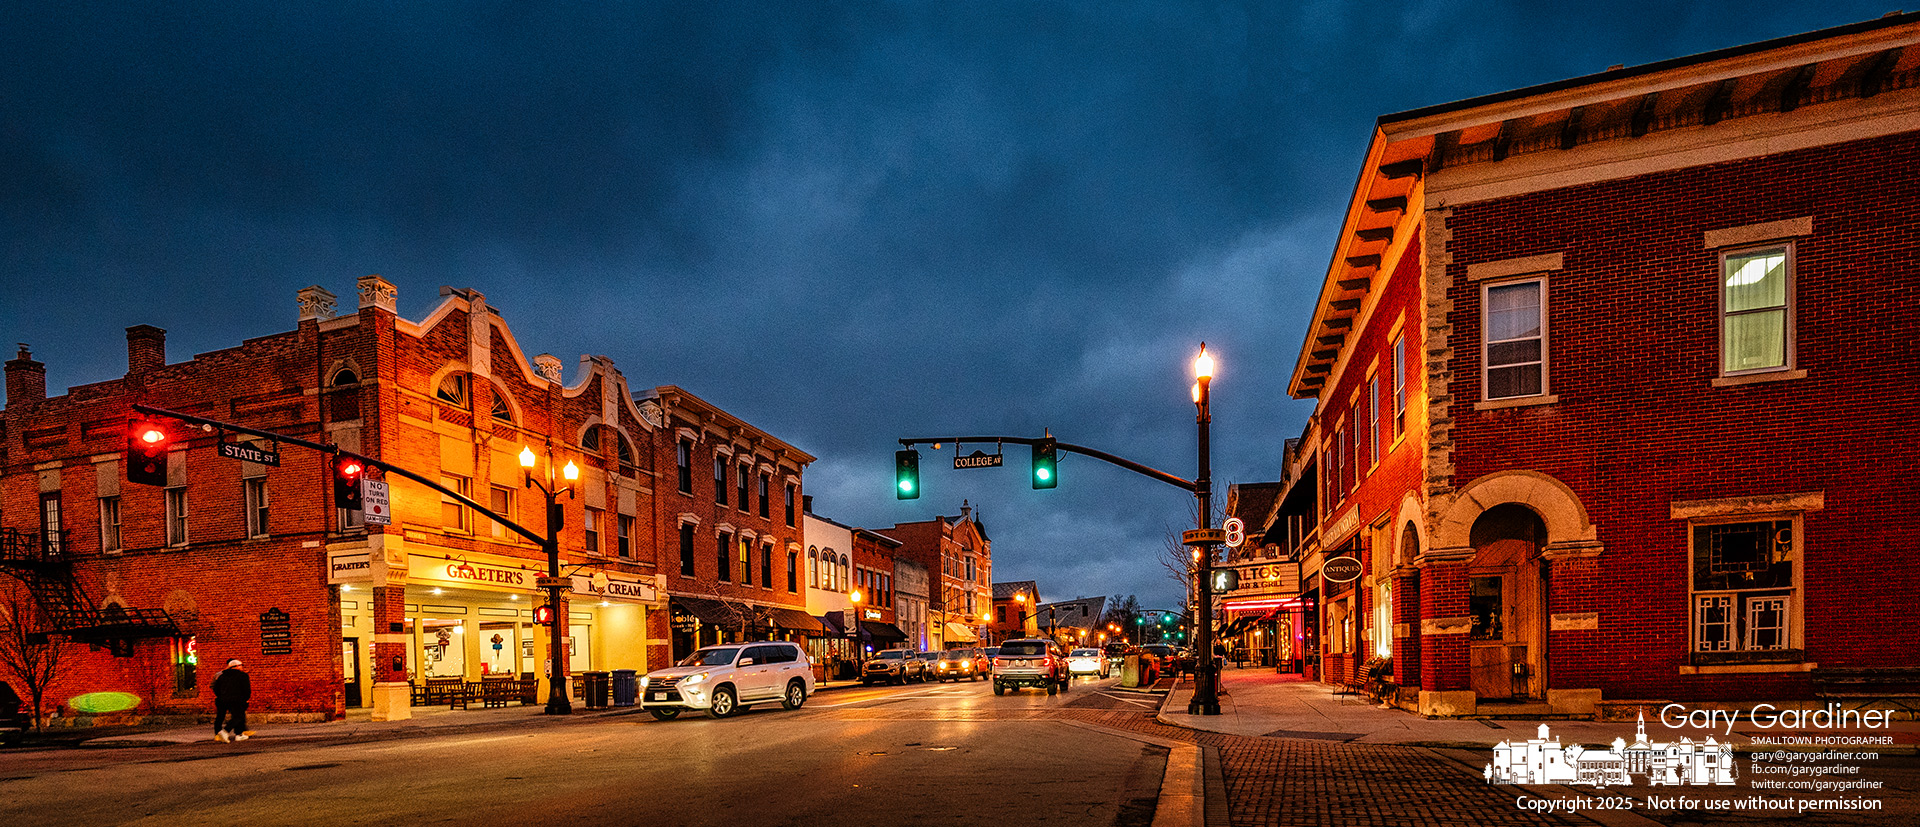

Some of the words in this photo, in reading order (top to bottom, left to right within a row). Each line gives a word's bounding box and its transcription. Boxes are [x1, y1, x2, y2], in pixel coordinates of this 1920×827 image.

[225, 445, 261, 461] STATE
[955, 457, 992, 467] COLLEGE
[370, 482, 382, 490] NO
[369, 490, 384, 498] TURN
[1223, 517, 1244, 547] 8
[333, 561, 370, 571] GRAETER'S
[1325, 565, 1360, 573] ANTIQUES
[446, 564, 523, 584] GRAETER'S
[588, 581, 605, 593] IC
[608, 583, 641, 596] CREAM
[1261, 580, 1284, 588] GRILL
